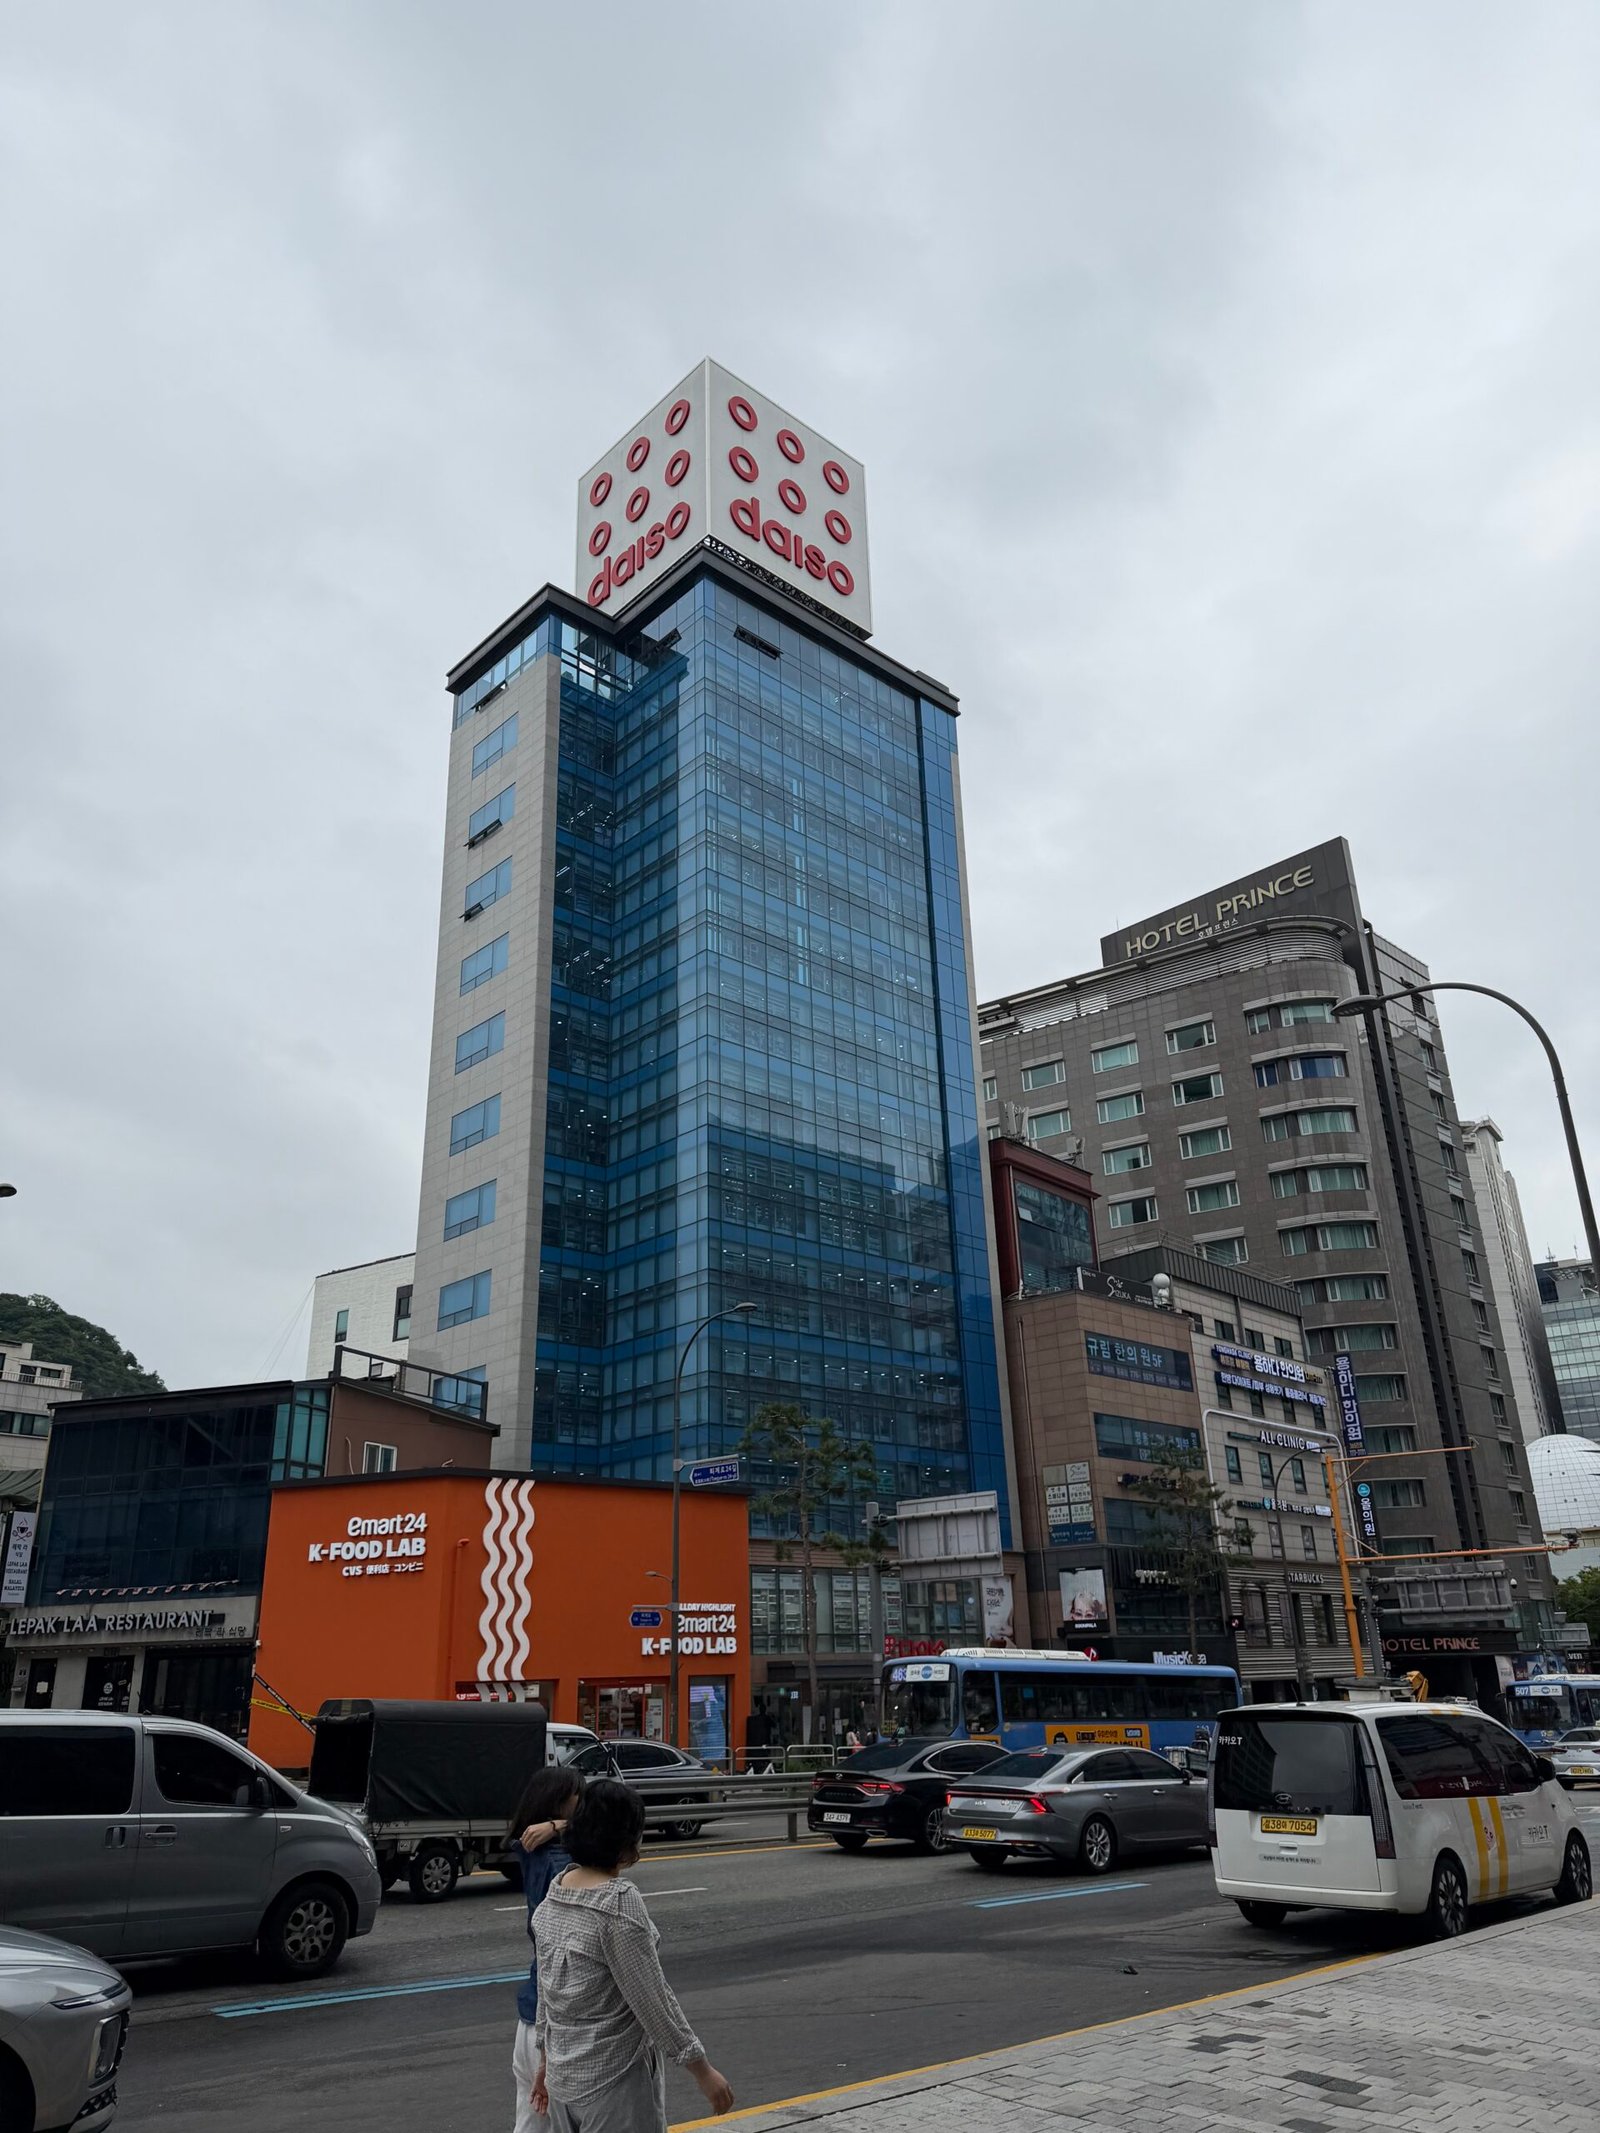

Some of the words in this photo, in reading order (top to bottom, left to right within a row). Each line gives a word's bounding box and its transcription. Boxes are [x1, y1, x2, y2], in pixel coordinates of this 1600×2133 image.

[587, 501, 691, 607] daiso
[730, 496, 855, 596] daiso
[1126, 912, 1209, 959] HOTEL
[1216, 865, 1315, 922] PRINCE
[1253, 1354, 1279, 1376] 용하다
[1280, 1360, 1306, 1383] 한의원
[1336, 1356, 1354, 1398] 용하다
[1342, 1399, 1362, 1441] 한의원
[1260, 1430, 1275, 1445] ALL
[1276, 1433, 1305, 1450] CLINIC
[347, 1512, 427, 1537] emart24
[308, 1540, 383, 1562] K-FOOD
[386, 1537, 426, 1558] LAB
[342, 1565, 362, 1576] CVS
[366, 1563, 390, 1575] 便利店
[394, 1561, 424, 1573] コンビニ
[700, 1603, 736, 1612] HIGHLIGHT
[10, 1616, 61, 1636] LEPAK
[63, 1614, 99, 1633] LAA
[105, 1610, 214, 1631] RESTAURANT
[706, 1637, 737, 1655] LAB
[1432, 1636, 1480, 1651] PRINCE
[1515, 1687, 1529, 1696] 507
[1218, 1735, 1243, 1746] 카카오T
[1289, 1820, 1313, 1832] 7054
